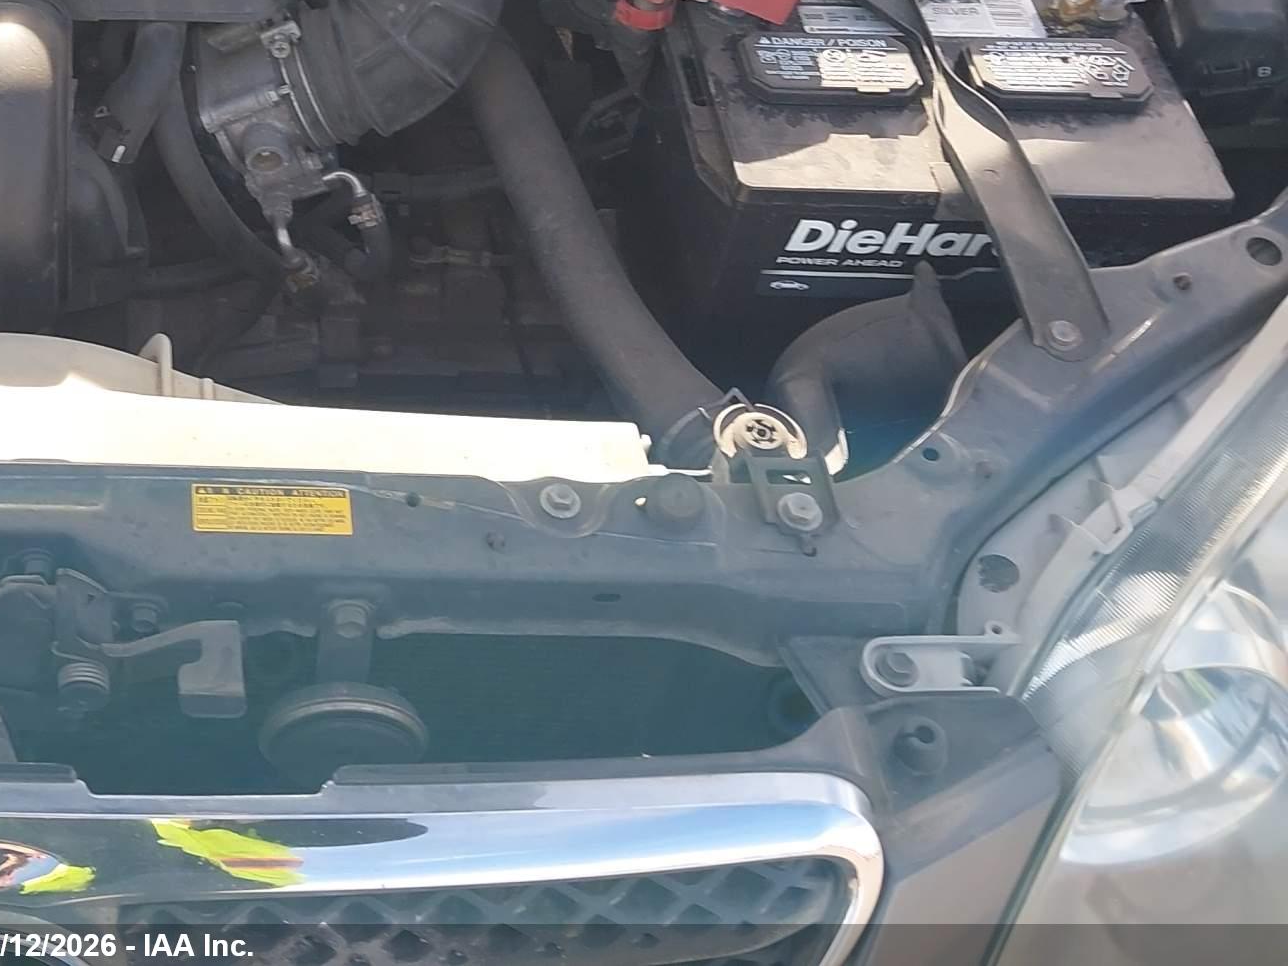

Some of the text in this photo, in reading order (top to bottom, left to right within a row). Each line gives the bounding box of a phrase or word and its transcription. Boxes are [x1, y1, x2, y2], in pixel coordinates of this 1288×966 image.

[932, 6, 980, 17] SILVER
[771, 36, 826, 47] DANGER
[838, 38, 888, 48] POISON
[784, 218, 1000, 257] DieHar
[775, 256, 904, 268] POWER AHEAD
